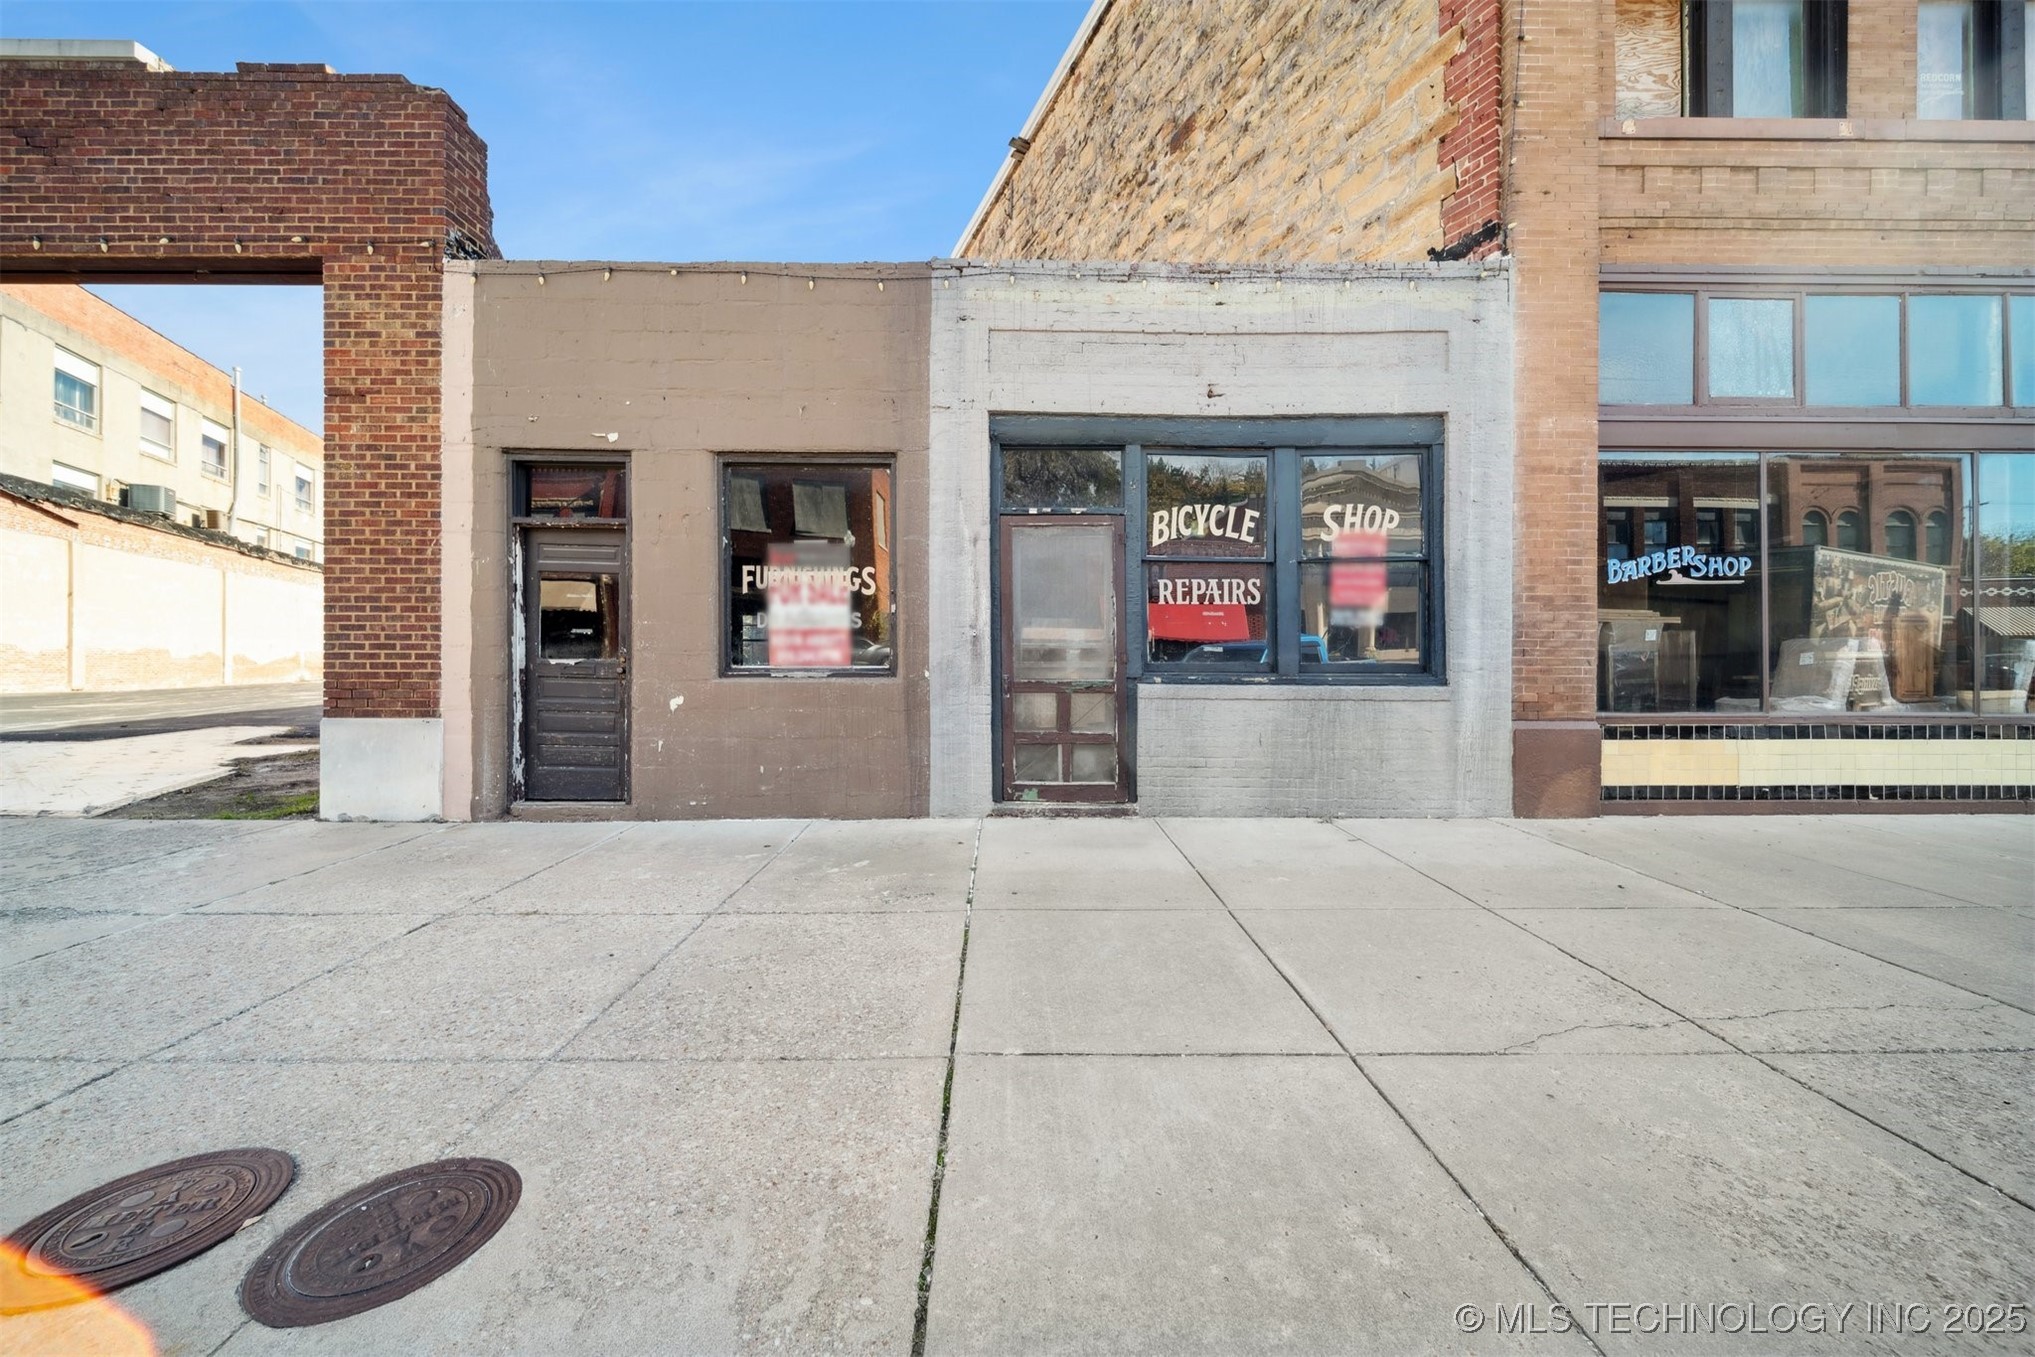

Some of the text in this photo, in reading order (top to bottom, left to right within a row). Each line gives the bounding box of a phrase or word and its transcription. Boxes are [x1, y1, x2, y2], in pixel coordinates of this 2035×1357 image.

[1920, 73, 1962, 82] REDCORN
[1152, 503, 1400, 548] BICYCLE SHOP
[1157, 578, 1261, 605] REPAIRS
